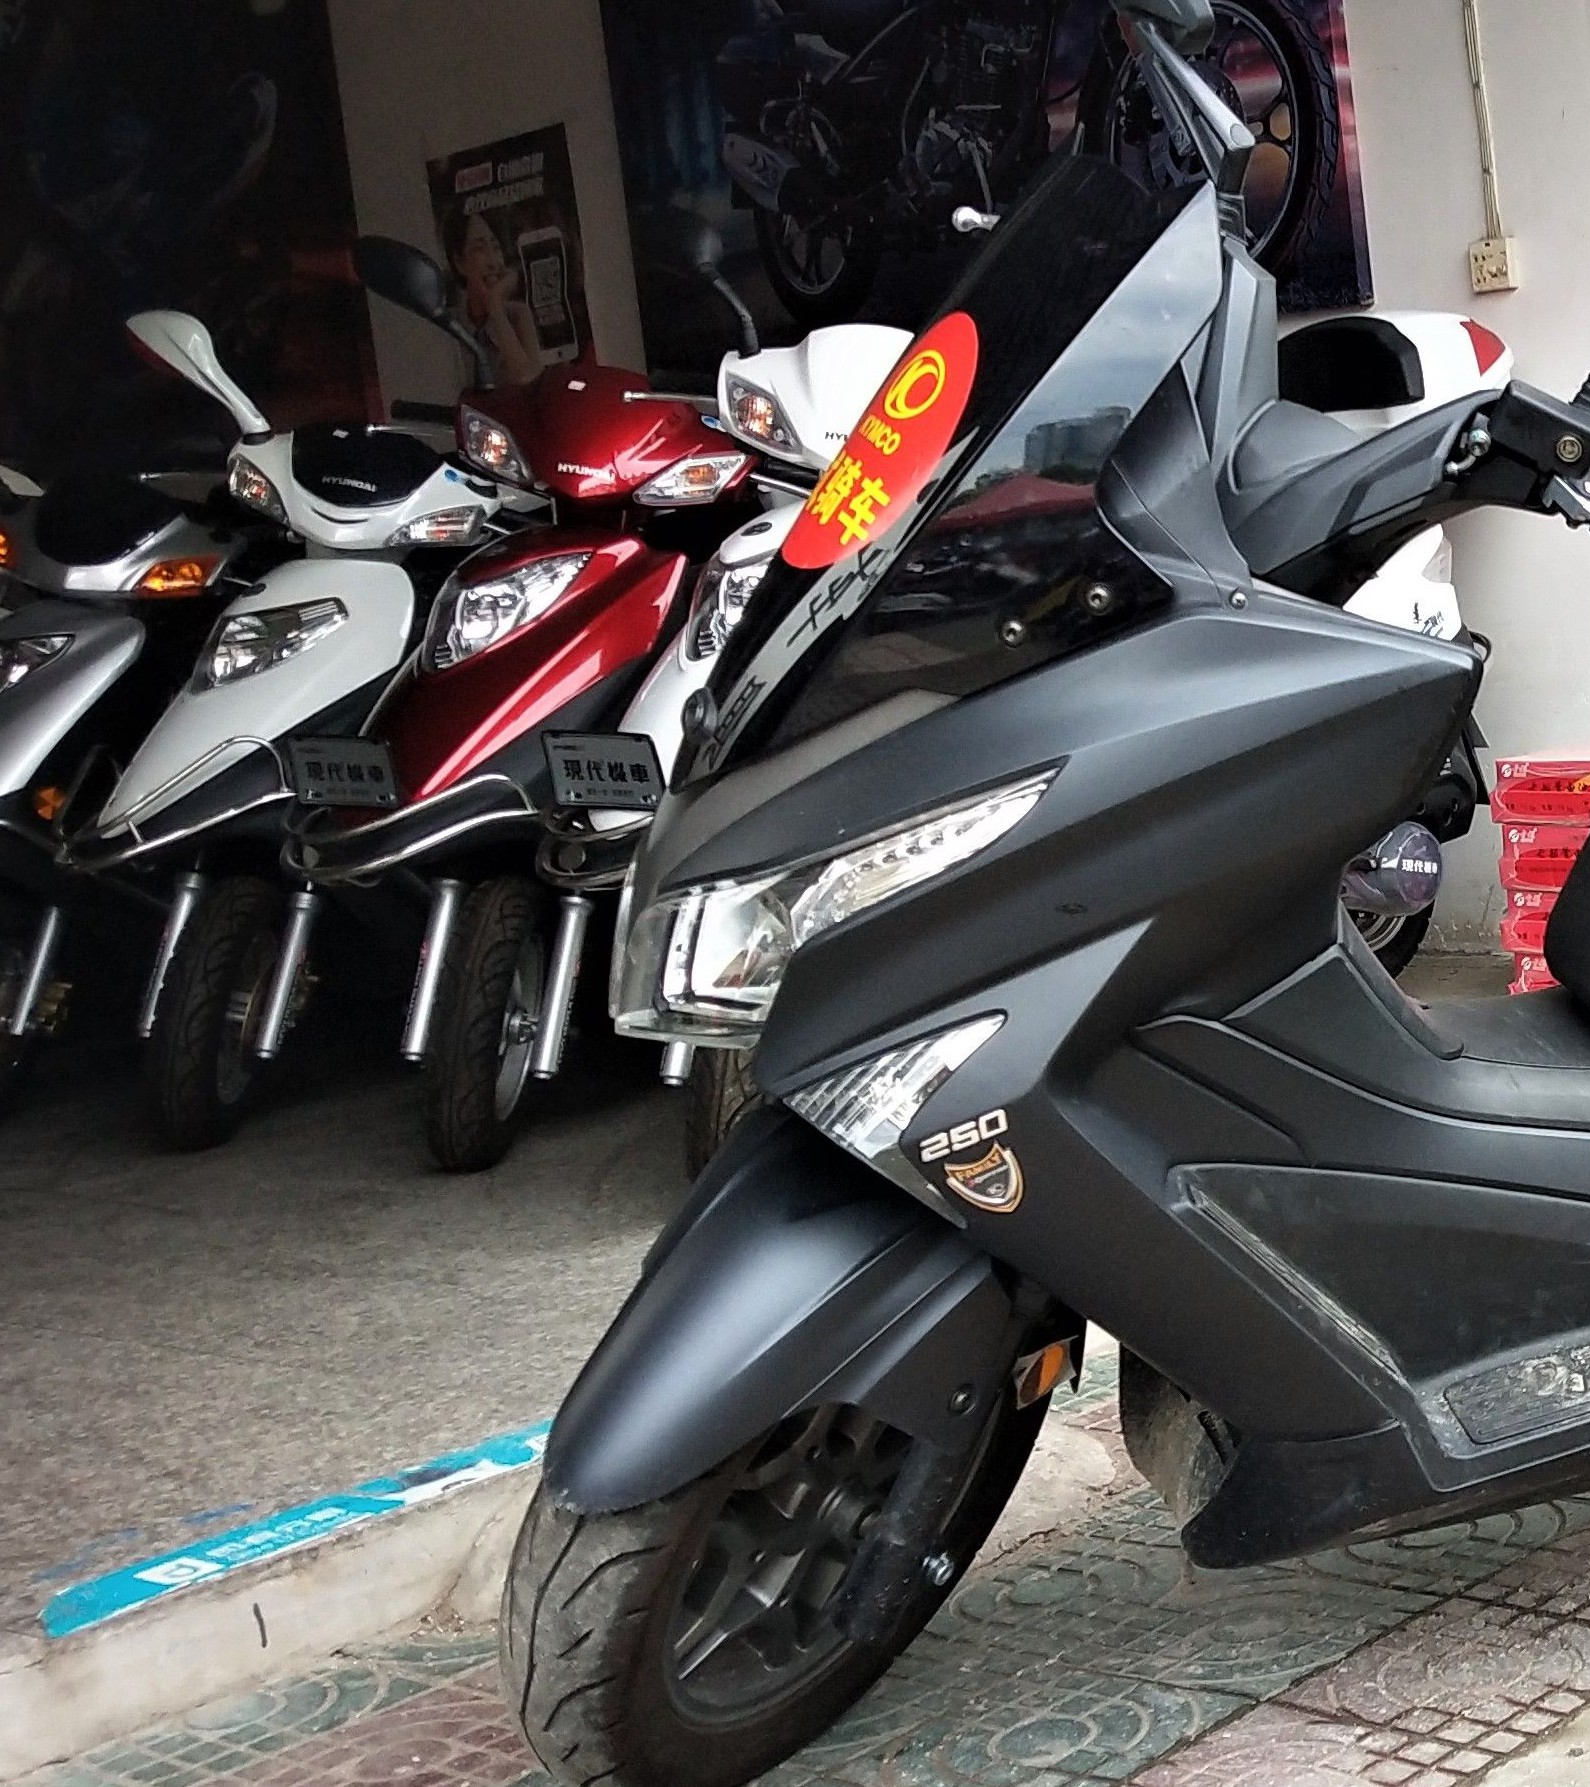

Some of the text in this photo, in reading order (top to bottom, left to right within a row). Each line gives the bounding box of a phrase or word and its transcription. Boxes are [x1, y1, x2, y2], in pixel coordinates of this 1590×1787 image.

[557, 462, 616, 482] HYUNDAI
[321, 475, 378, 493] HYUNDAI
[919, 1108, 1009, 1163] 250
